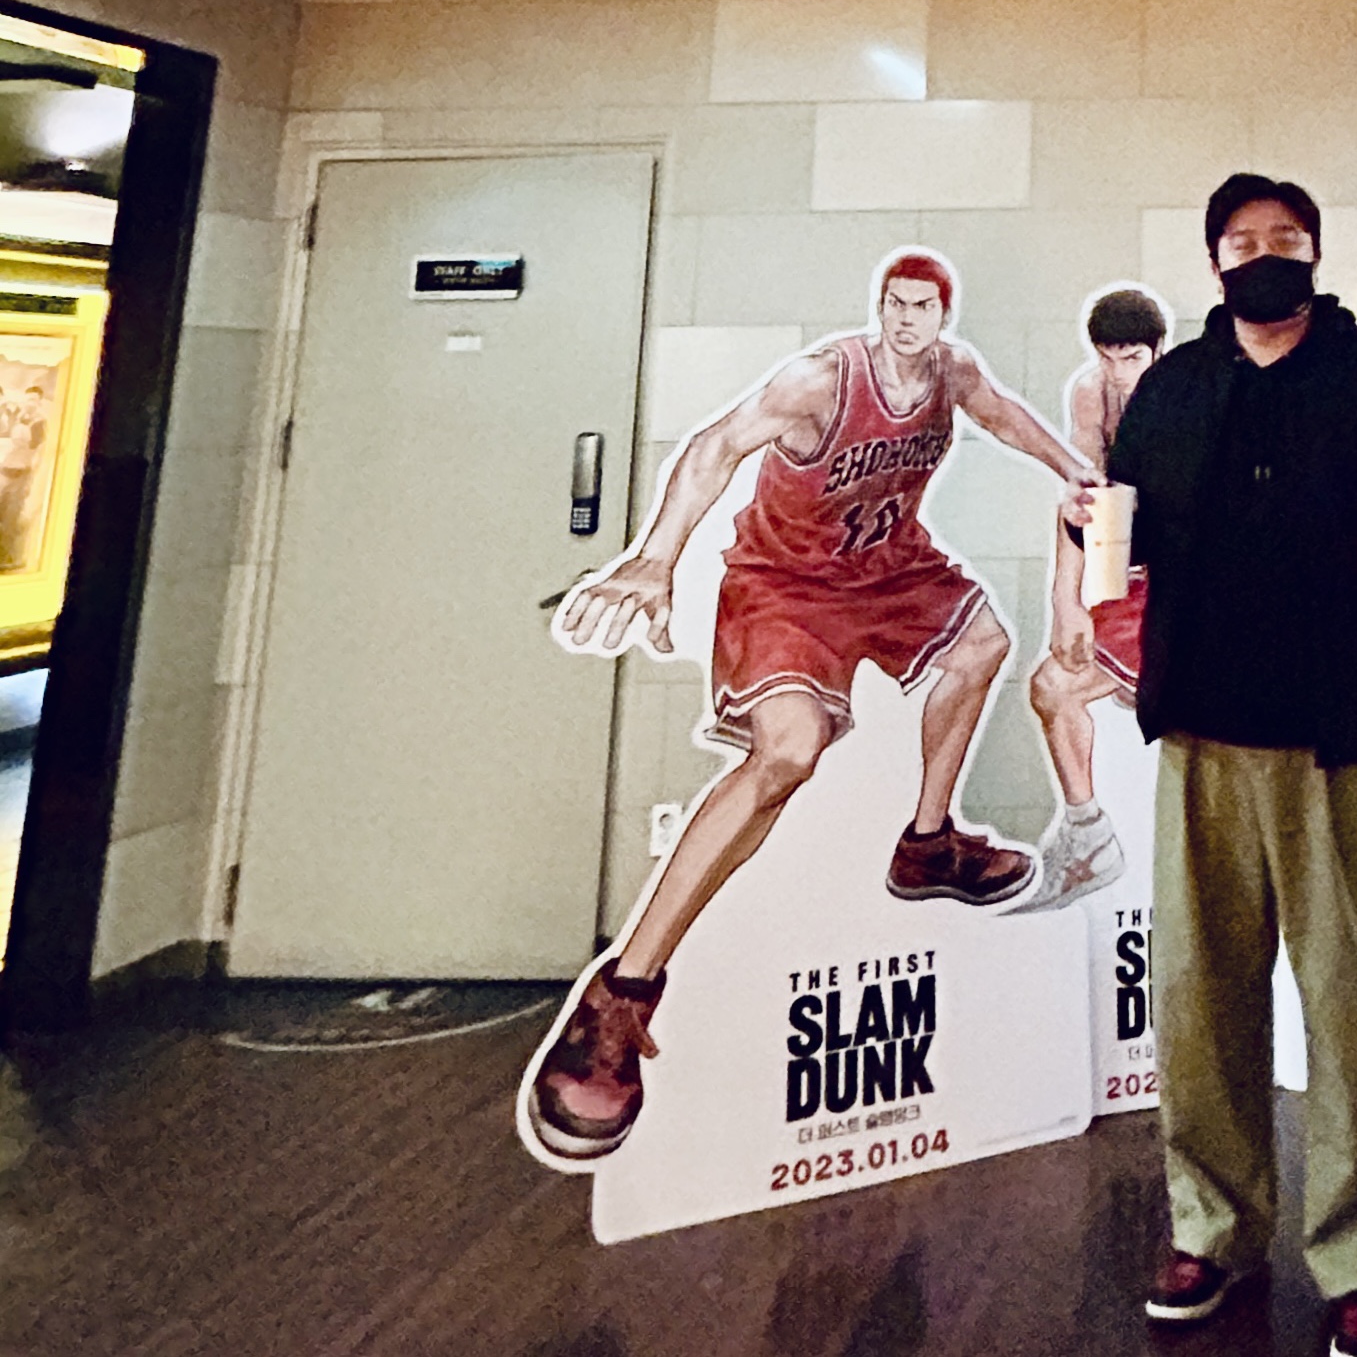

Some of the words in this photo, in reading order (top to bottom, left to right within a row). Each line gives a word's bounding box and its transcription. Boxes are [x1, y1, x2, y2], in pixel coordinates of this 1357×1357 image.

[834, 495, 904, 557] 10
[1115, 907, 1153, 928] TH
[789, 965, 839, 993] THE
[857, 950, 936, 983] FIRST
[1115, 929, 1152, 987] S
[786, 974, 936, 1058] SLAM
[1116, 984, 1153, 1041] D
[785, 1033, 936, 1123] DUNK
[771, 1128, 950, 1192] 2023.01.04
